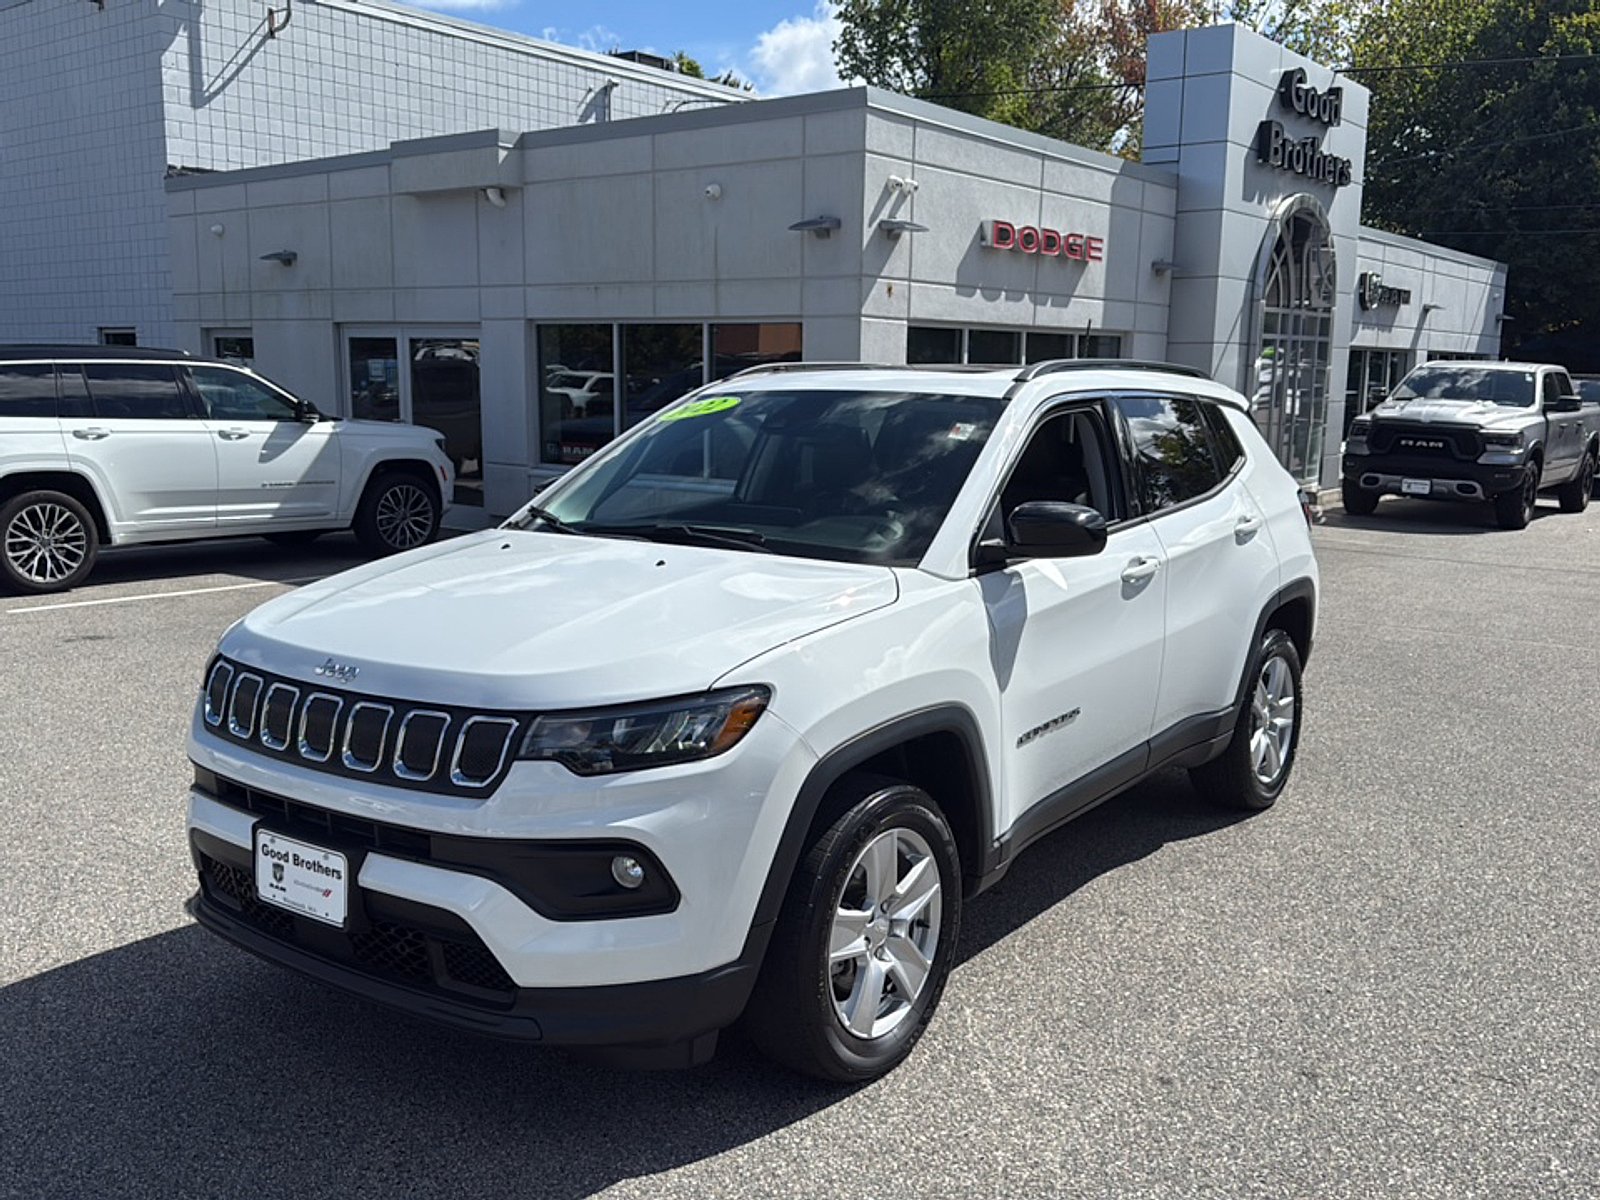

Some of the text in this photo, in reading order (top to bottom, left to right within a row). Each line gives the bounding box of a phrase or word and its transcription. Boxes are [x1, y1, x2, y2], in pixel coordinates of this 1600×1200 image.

[1285, 67, 1342, 127] Good
[1263, 120, 1352, 187] Brothers
[991, 219, 1105, 262] DODGE
[1400, 439, 1444, 448] RAM
[261, 843, 343, 880] Good Brothers
